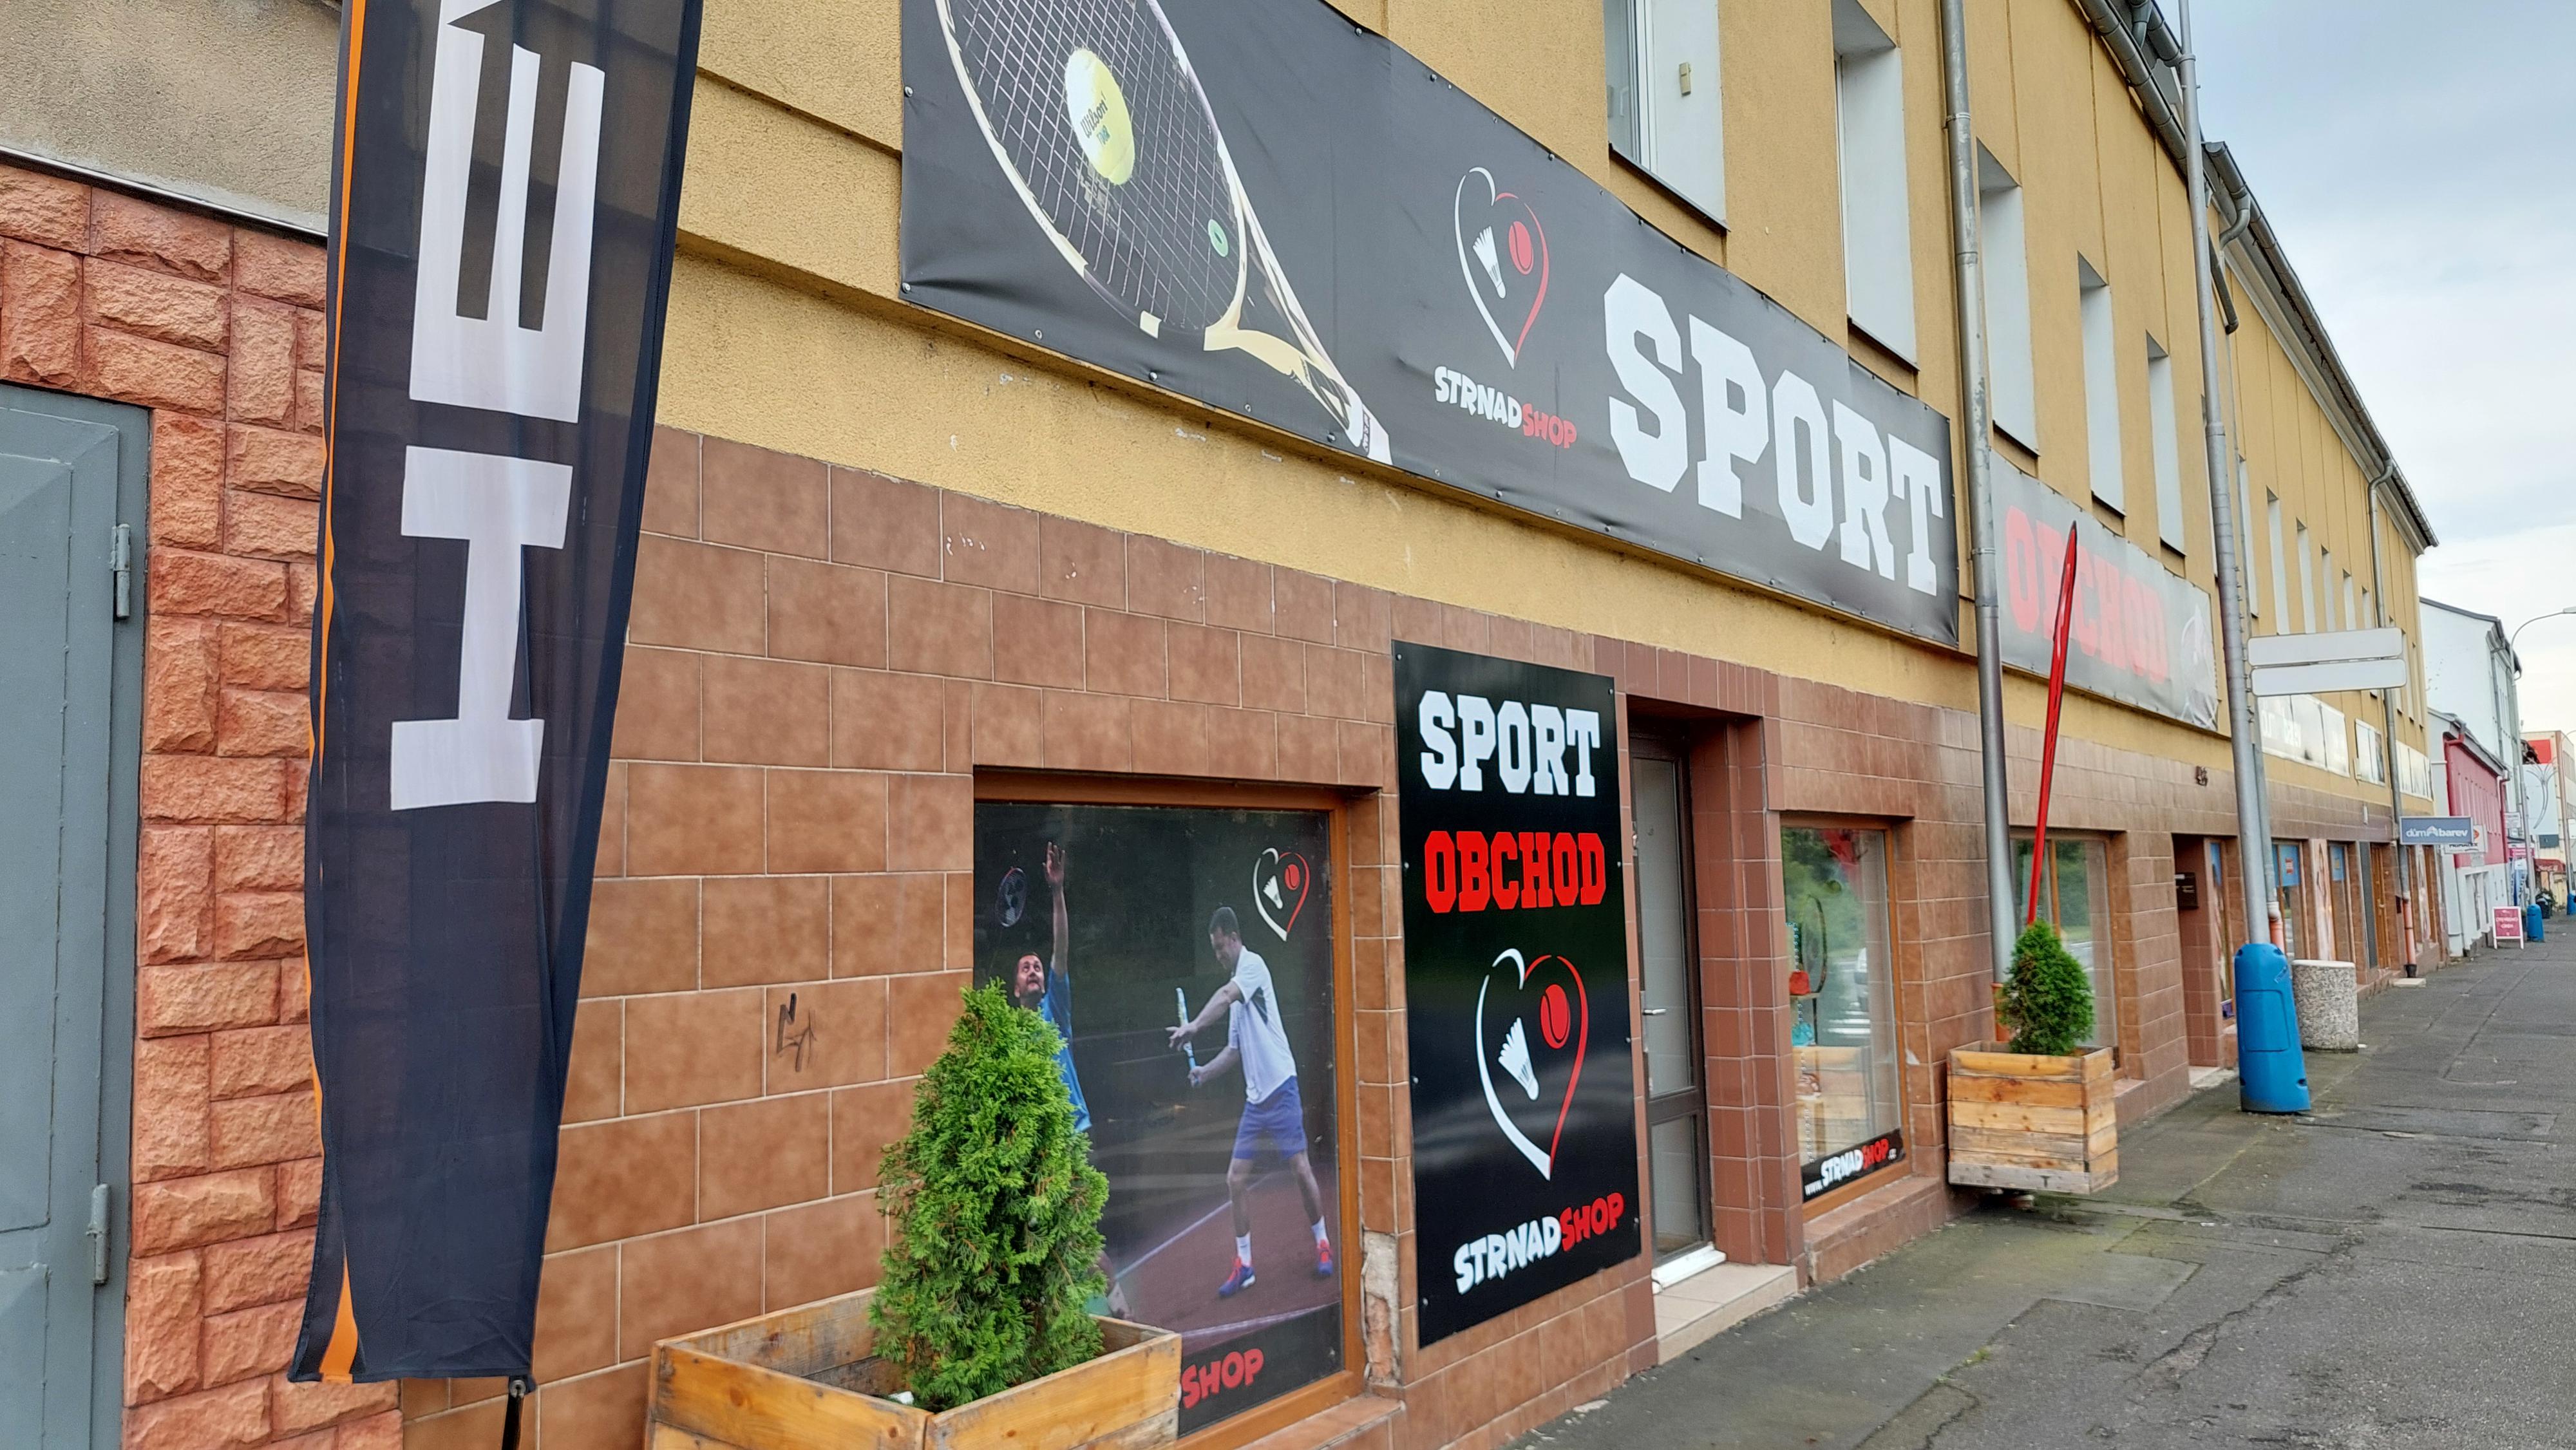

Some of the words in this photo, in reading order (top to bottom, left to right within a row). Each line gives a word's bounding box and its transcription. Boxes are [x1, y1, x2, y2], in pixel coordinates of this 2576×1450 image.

[1603, 272, 1944, 596] SPORT
[1419, 690, 1600, 797] SPORT
[1425, 831, 1606, 914] OBCHOD
[2439, 828, 2468, 837] barev
[1454, 1192, 1625, 1295] STRNADSHOP
[1178, 1348, 1264, 1409] SHOP
